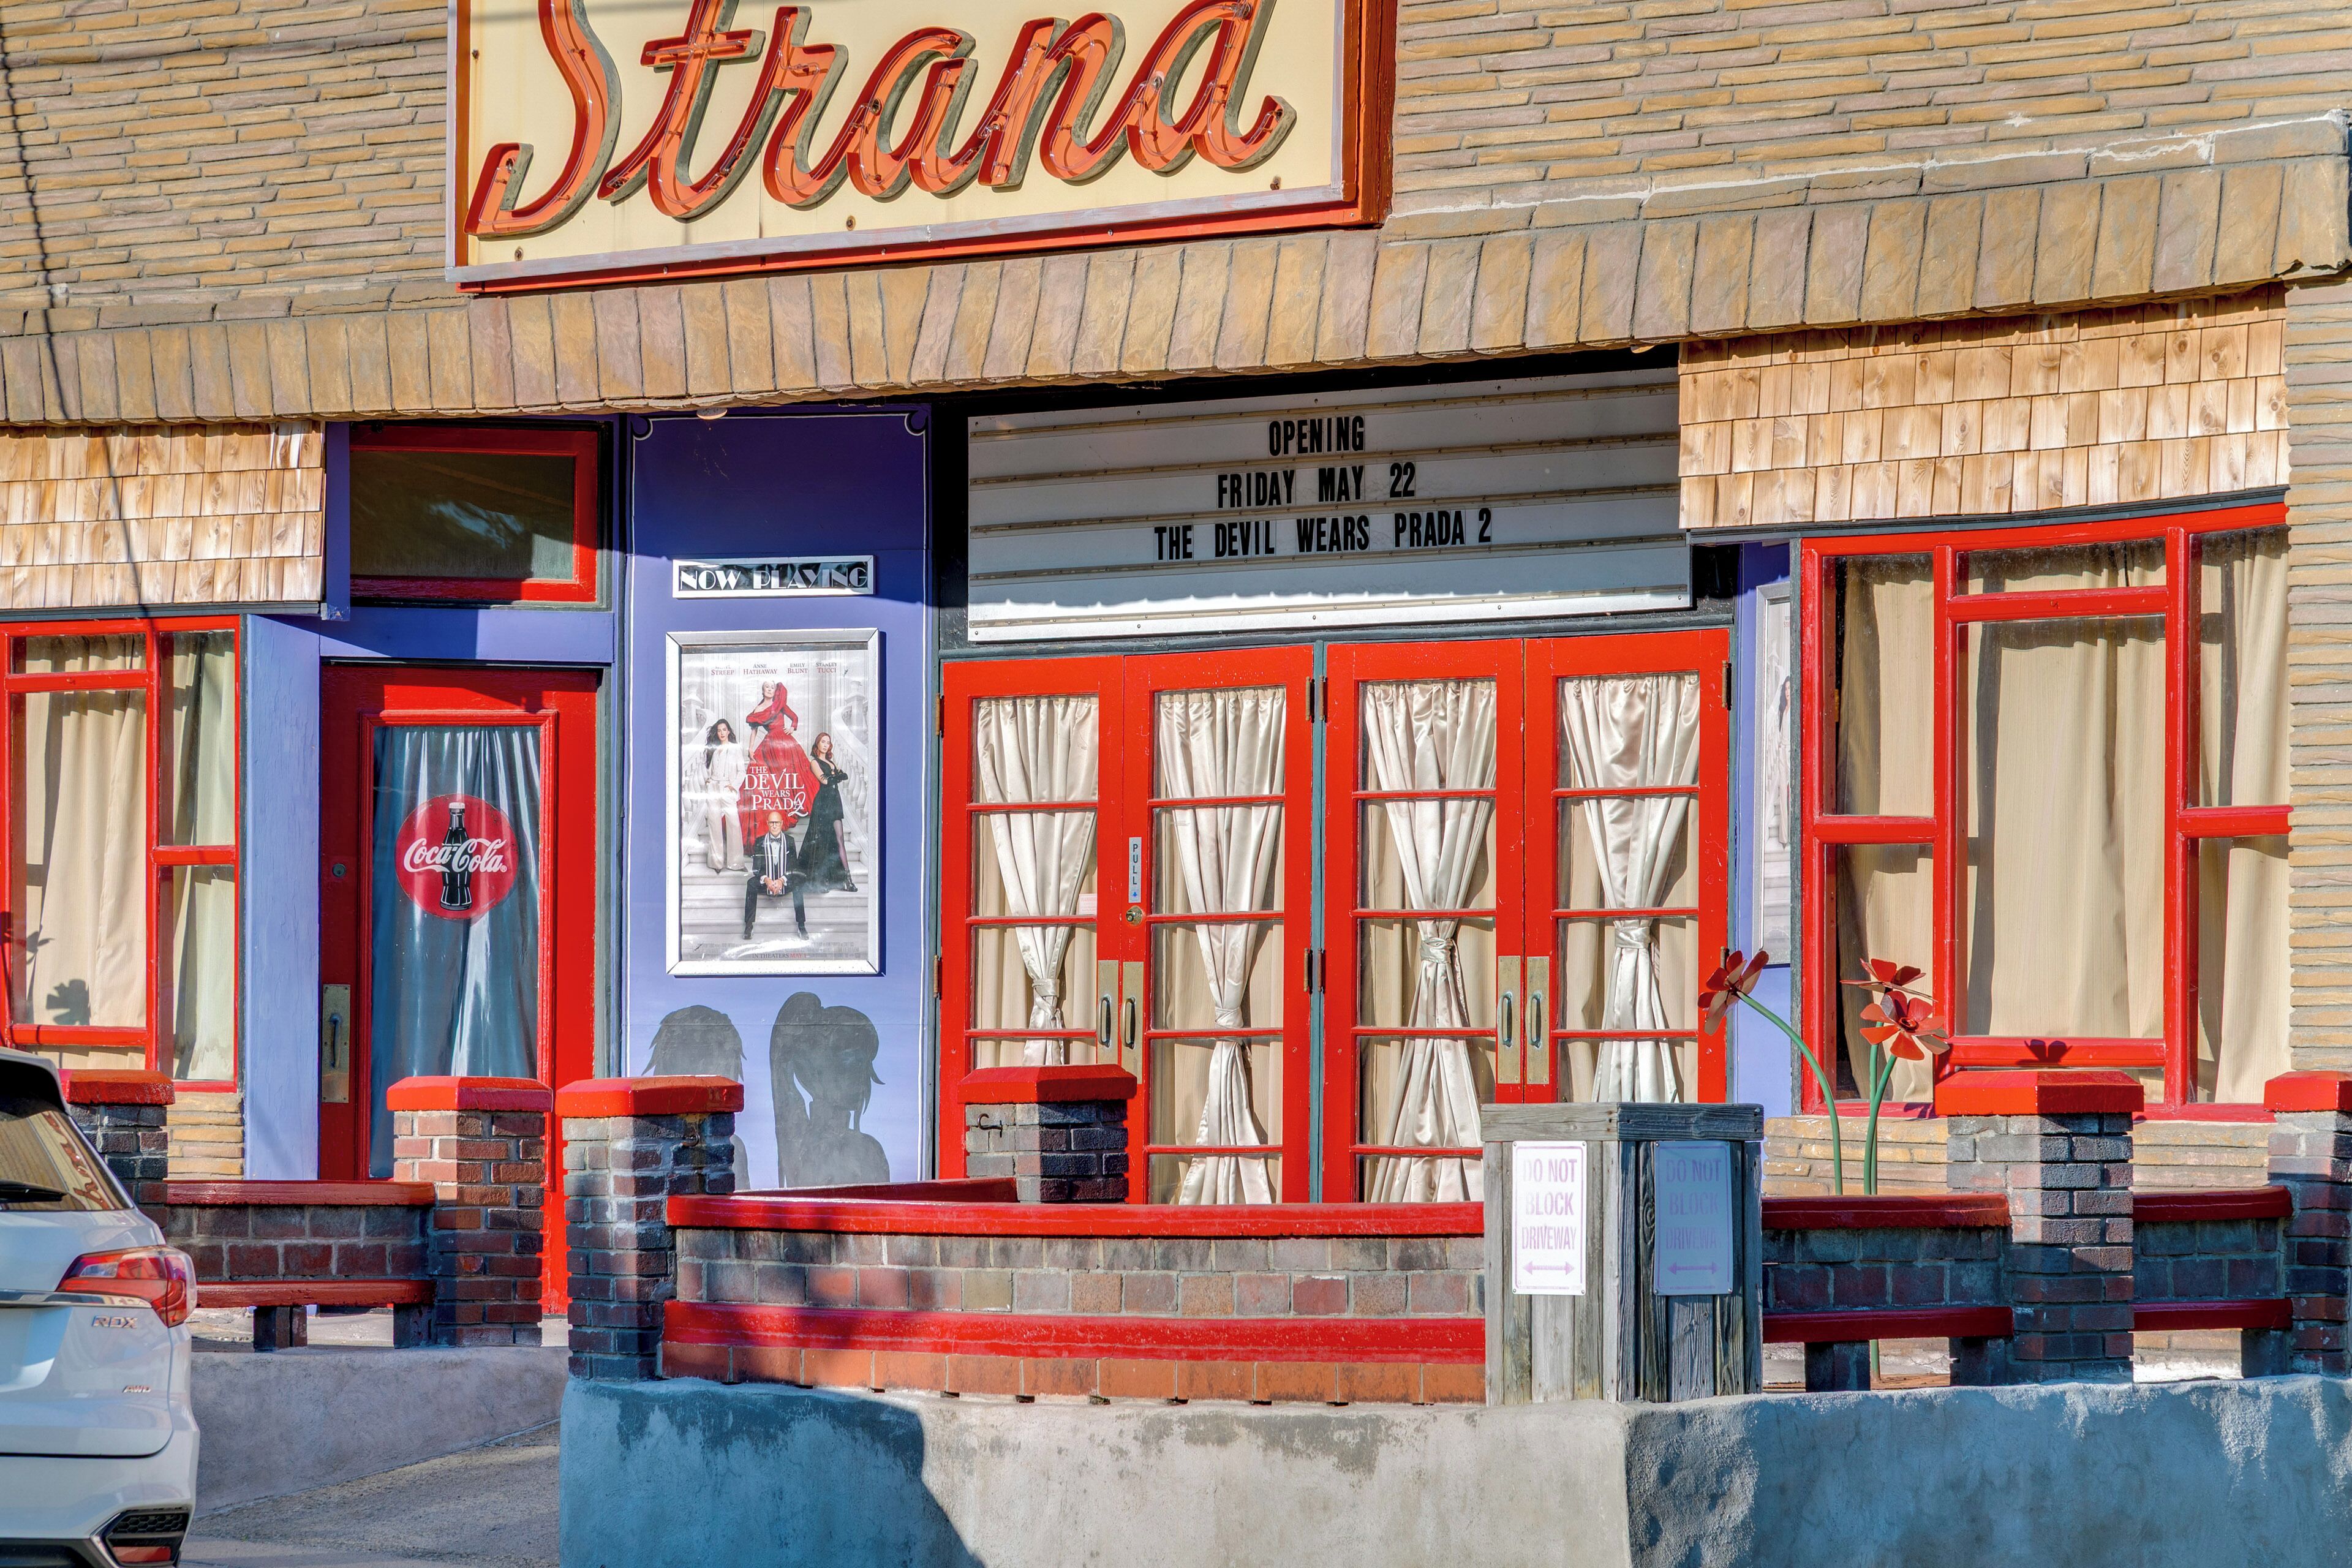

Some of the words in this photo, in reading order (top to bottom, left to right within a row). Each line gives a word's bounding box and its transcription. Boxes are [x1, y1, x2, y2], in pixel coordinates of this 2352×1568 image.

[466, 0, 1296, 237] Strand
[1268, 416, 1365, 456] OPENING
[1218, 470, 1295, 508] FRIDAY
[1318, 466, 1364, 502] MAY
[1390, 462, 1416, 498] 22
[1154, 526, 1194, 560] THE
[1215, 521, 1275, 557] DEVIL
[1297, 515, 1370, 552] WEARS
[1395, 510, 1465, 548] PRADA
[1479, 508, 1491, 543] 2
[680, 570, 741, 590] NOW
[753, 567, 867, 589] PLAYING
[744, 767, 804, 790] DEVIL
[751, 794, 804, 810] PRADA
[788, 791, 809, 816] 2
[1523, 1158, 1543, 1183] DO
[1548, 1158, 1577, 1183] NOT
[1666, 1159, 1687, 1183] DO
[1692, 1158, 1721, 1182] NOT
[1525, 1191, 1574, 1216] BLOCK
[1669, 1191, 1719, 1216] BLOCK
[1521, 1226, 1577, 1250] DRIVEWAY
[1665, 1226, 1720, 1250] DRIVEWA
[92, 1316, 138, 1329] RDX
